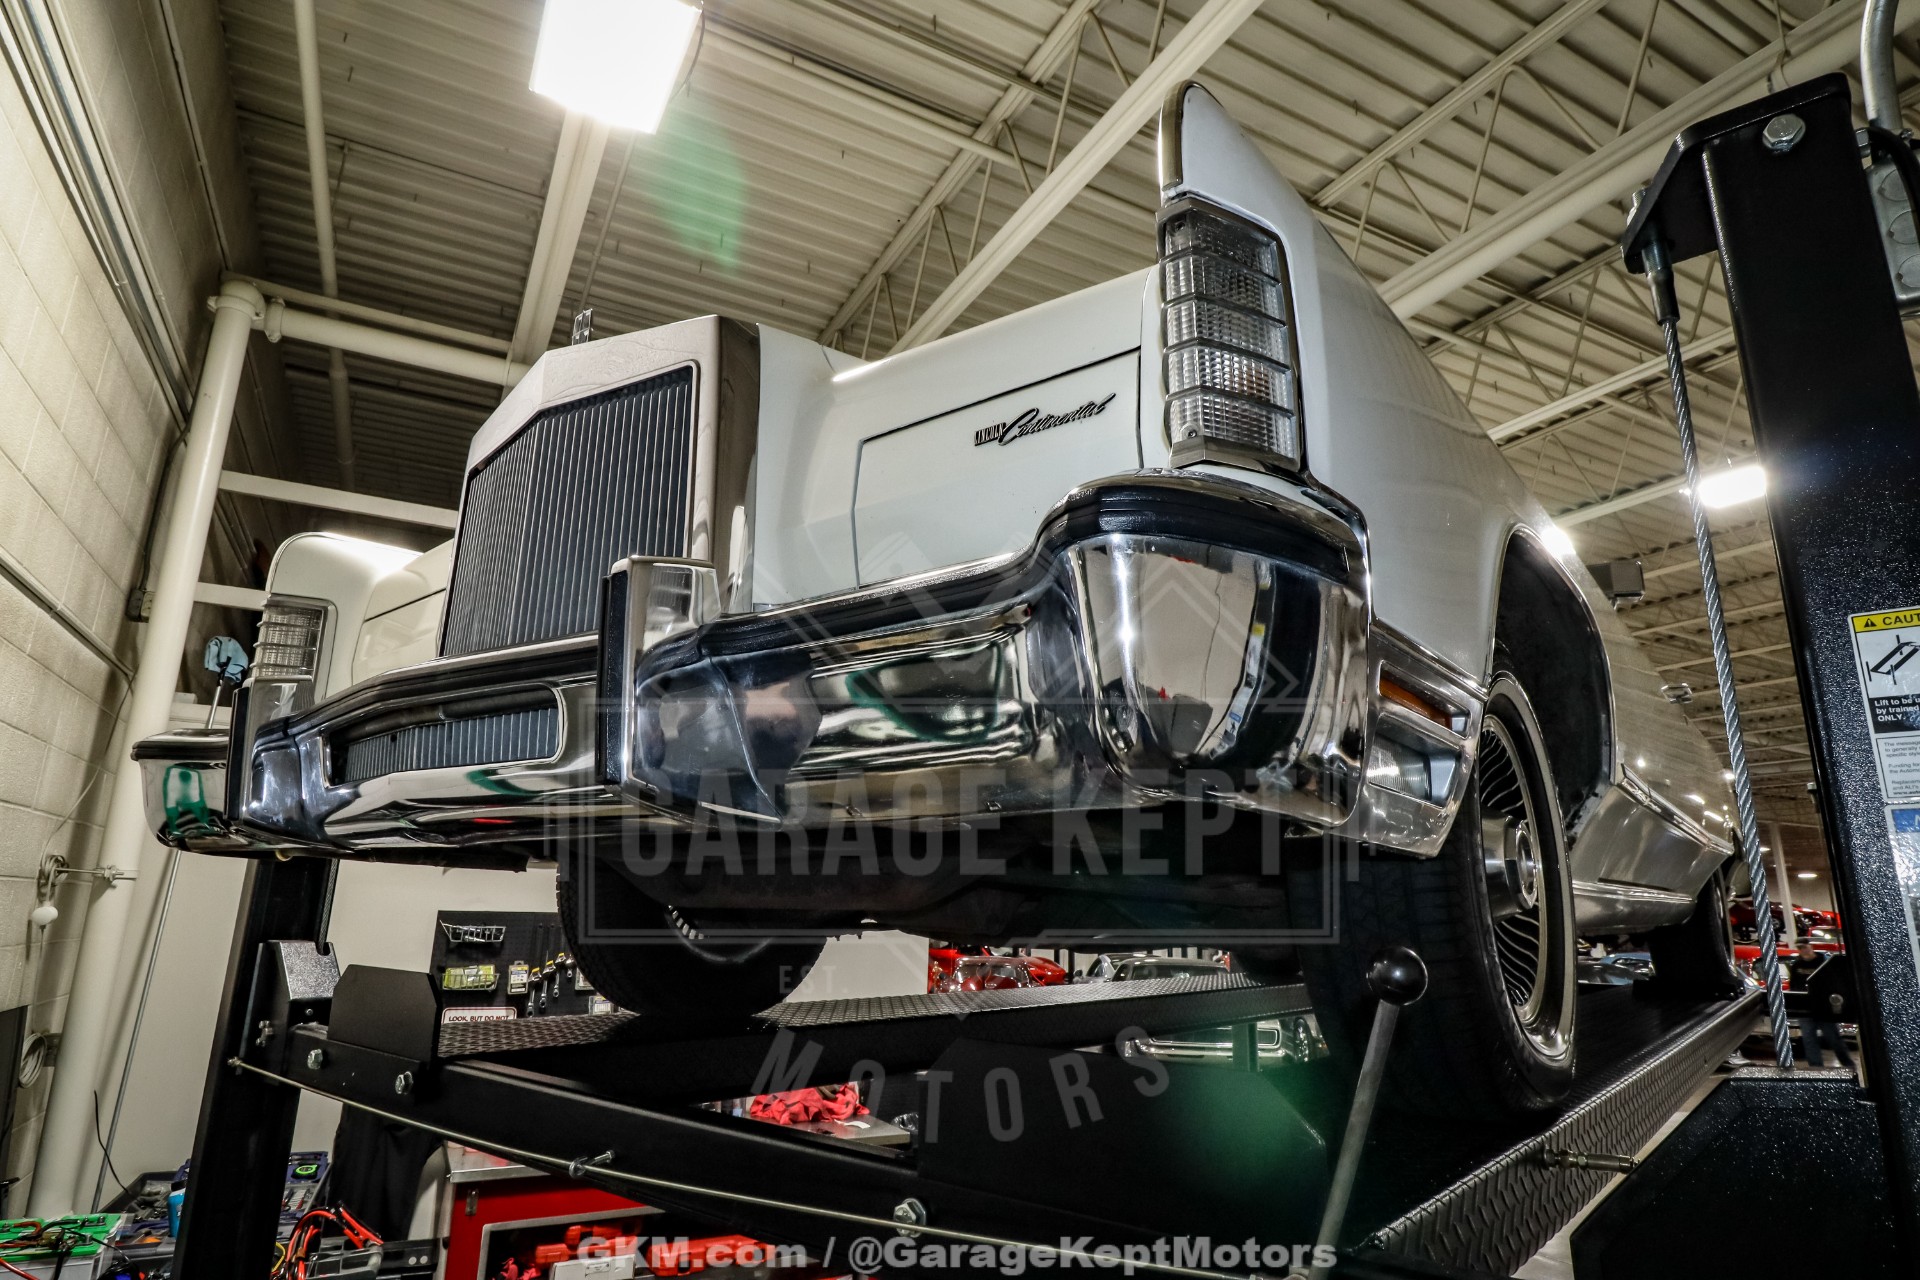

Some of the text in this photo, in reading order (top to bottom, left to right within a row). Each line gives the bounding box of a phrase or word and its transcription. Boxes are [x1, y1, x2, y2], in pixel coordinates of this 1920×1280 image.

[973, 393, 1117, 446] LINCOLN Continental
[1874, 699, 1889, 707] Lift
[1888, 705, 1920, 713] trained
[1877, 714, 1907, 722] ONLY.
